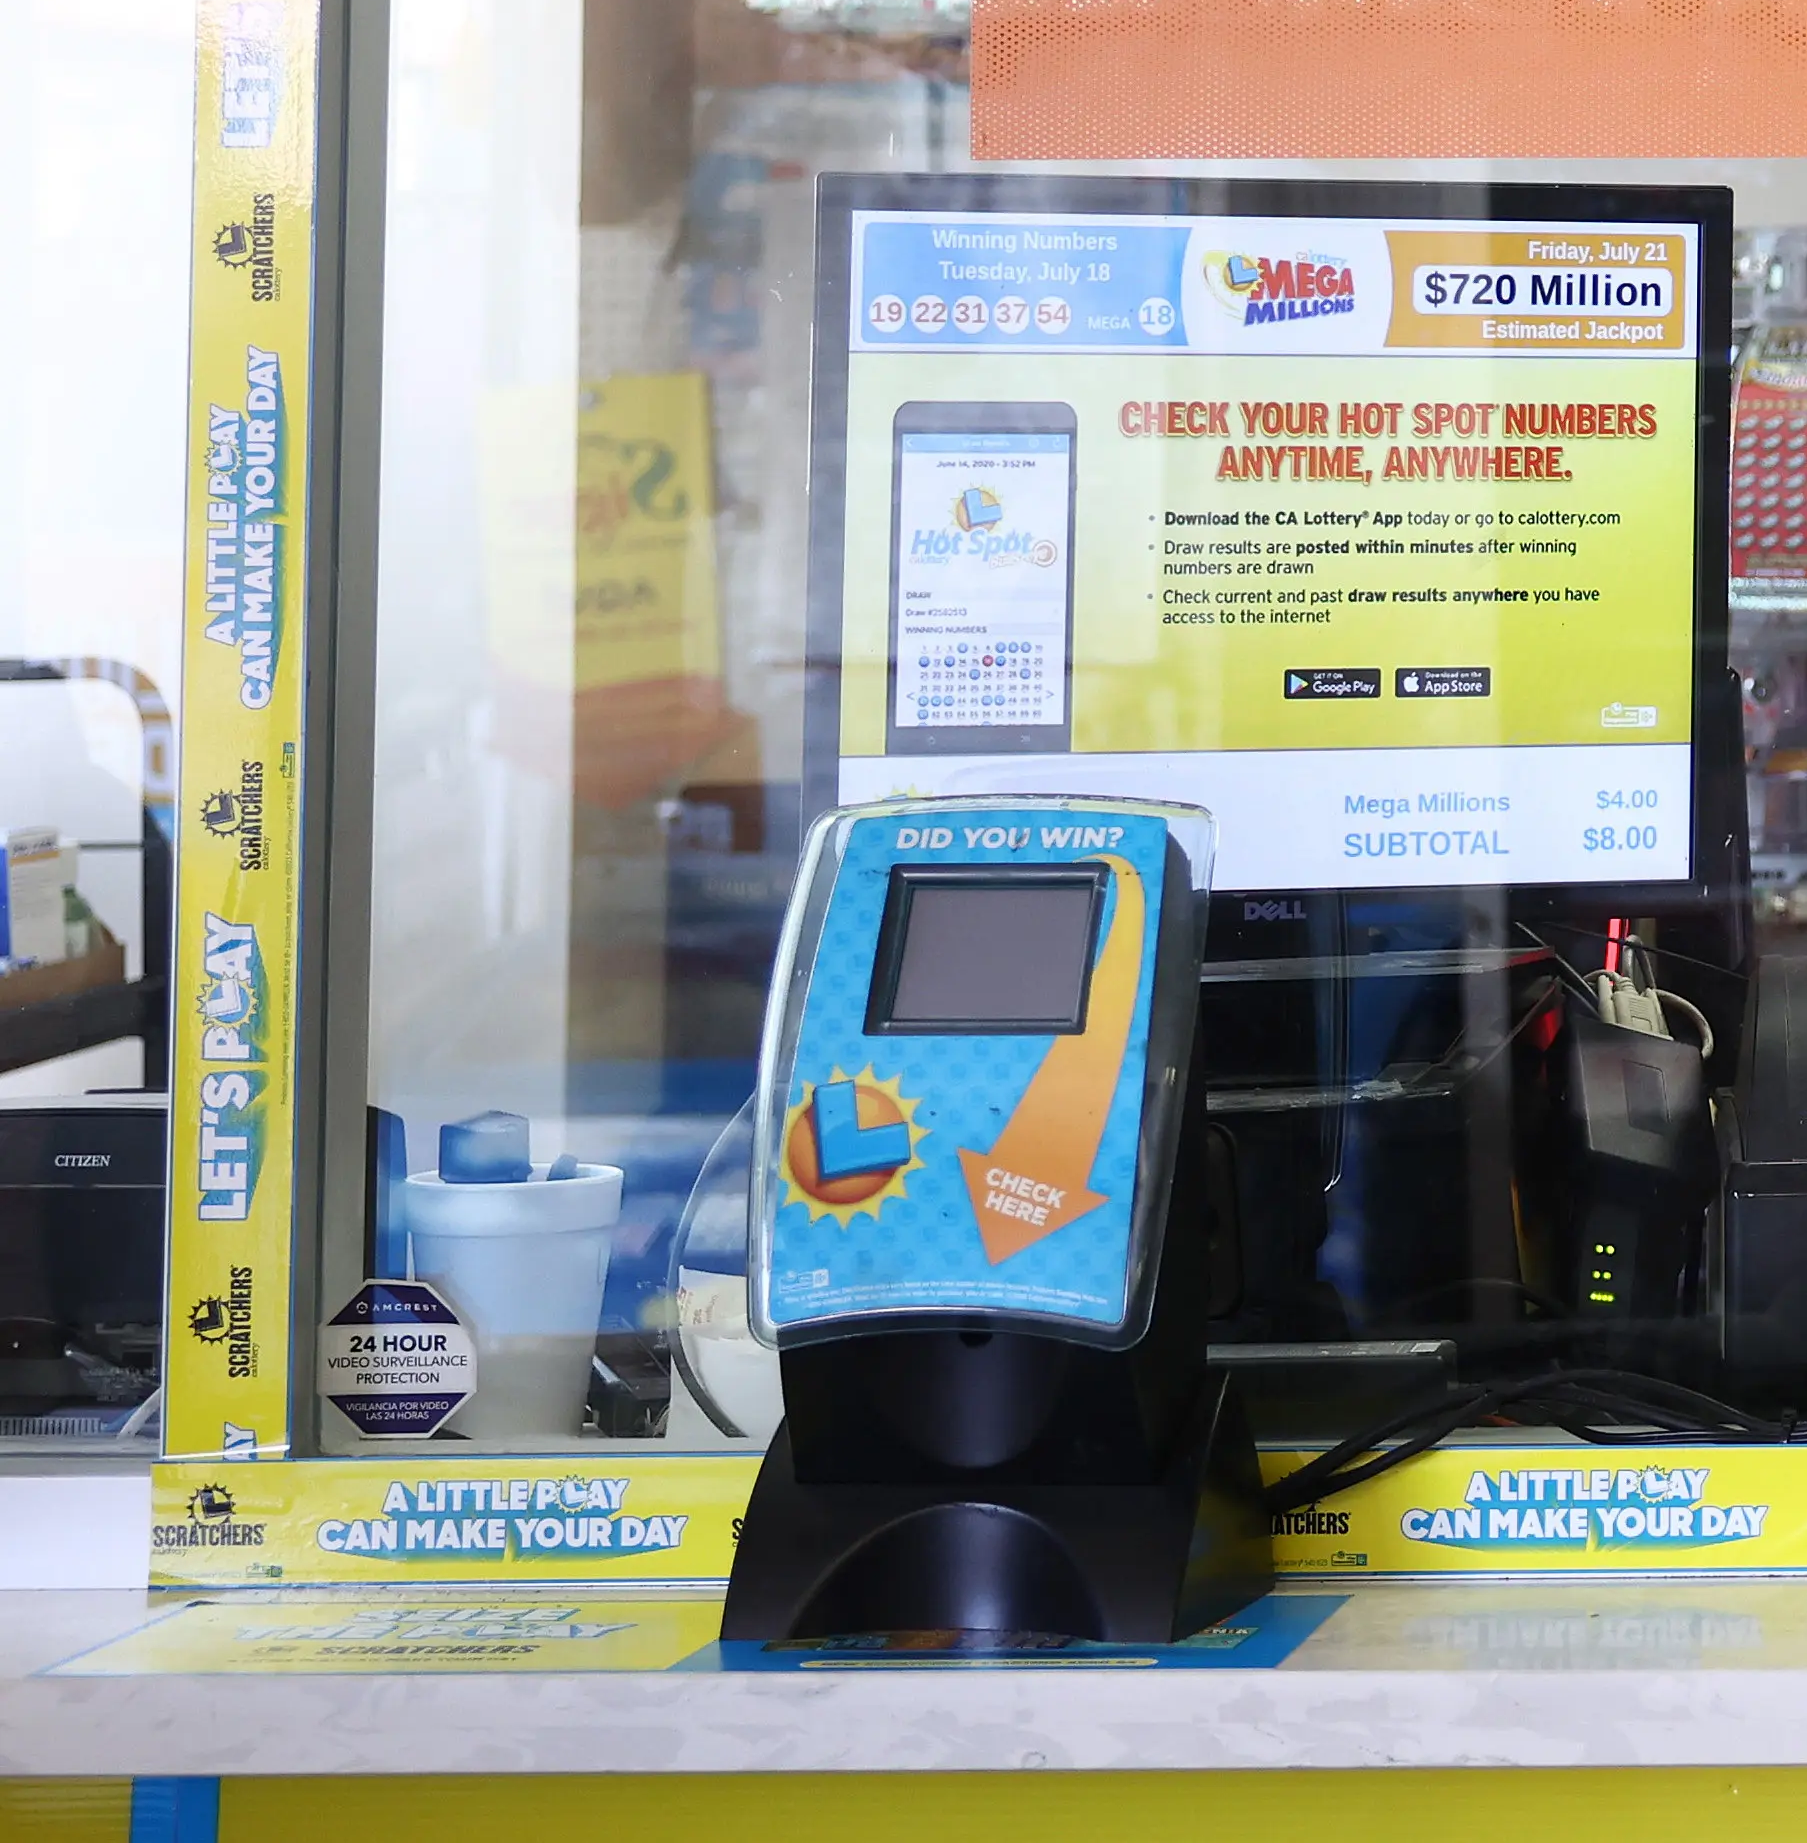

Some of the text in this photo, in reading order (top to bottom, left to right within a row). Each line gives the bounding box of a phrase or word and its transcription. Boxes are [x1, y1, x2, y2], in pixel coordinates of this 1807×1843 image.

[252, 193, 276, 303] SCRATCHERS
[932, 229, 1118, 252] Winning Numbers
[1528, 241, 1668, 265] Friday, July 21
[938, 261, 1110, 285] Tuesday, July 18
[1249, 256, 1355, 300] MEGA
[1424, 271, 1662, 309] $720 Million
[871, 302, 1172, 331] 19 22 31 37 54 MEGA 18
[1244, 297, 1355, 327] MILLIONS
[1483, 318, 1664, 344] Estimated Jackpot
[1119, 401, 1658, 438] CHECK YOUR HOT SPOT NUMBERS
[1216, 446, 1573, 485] ANYTIME, ANYWHERE.
[1164, 510, 1239, 527] Download
[1245, 510, 1270, 527] the
[1275, 511, 1298, 527] CA
[1372, 511, 1402, 531] App
[1407, 510, 1449, 531] today
[1454, 514, 1471, 527] or
[1475, 514, 1494, 531] go
[1498, 511, 1514, 527] to
[1518, 510, 1621, 531] calottery.com
[1163, 538, 1577, 558] Draw results are posted within minutes after winning
[1313, 680, 1376, 696] Google Play
[1424, 679, 1483, 695] App Store
[1344, 789, 1658, 818] Mega Millions $4.00
[897, 825, 1125, 851] DID YOU WIN?
[1344, 825, 1657, 857] SUBTOTAL $8.00
[54, 1154, 111, 1168] CITIZEN
[984, 1166, 1065, 1213] CHECK
[984, 1190, 1048, 1227] HERE
[373, 1302, 438, 1312] AMCREST
[350, 1334, 447, 1353] 24 HOUR
[328, 1355, 468, 1369] VIDEO SURVEILLANCE
[356, 1372, 440, 1385] PROTECTION
[346, 1400, 449, 1412] VIGILANCIA POR VIDEO
[366, 1410, 429, 1421] LAS 24 HORAS
